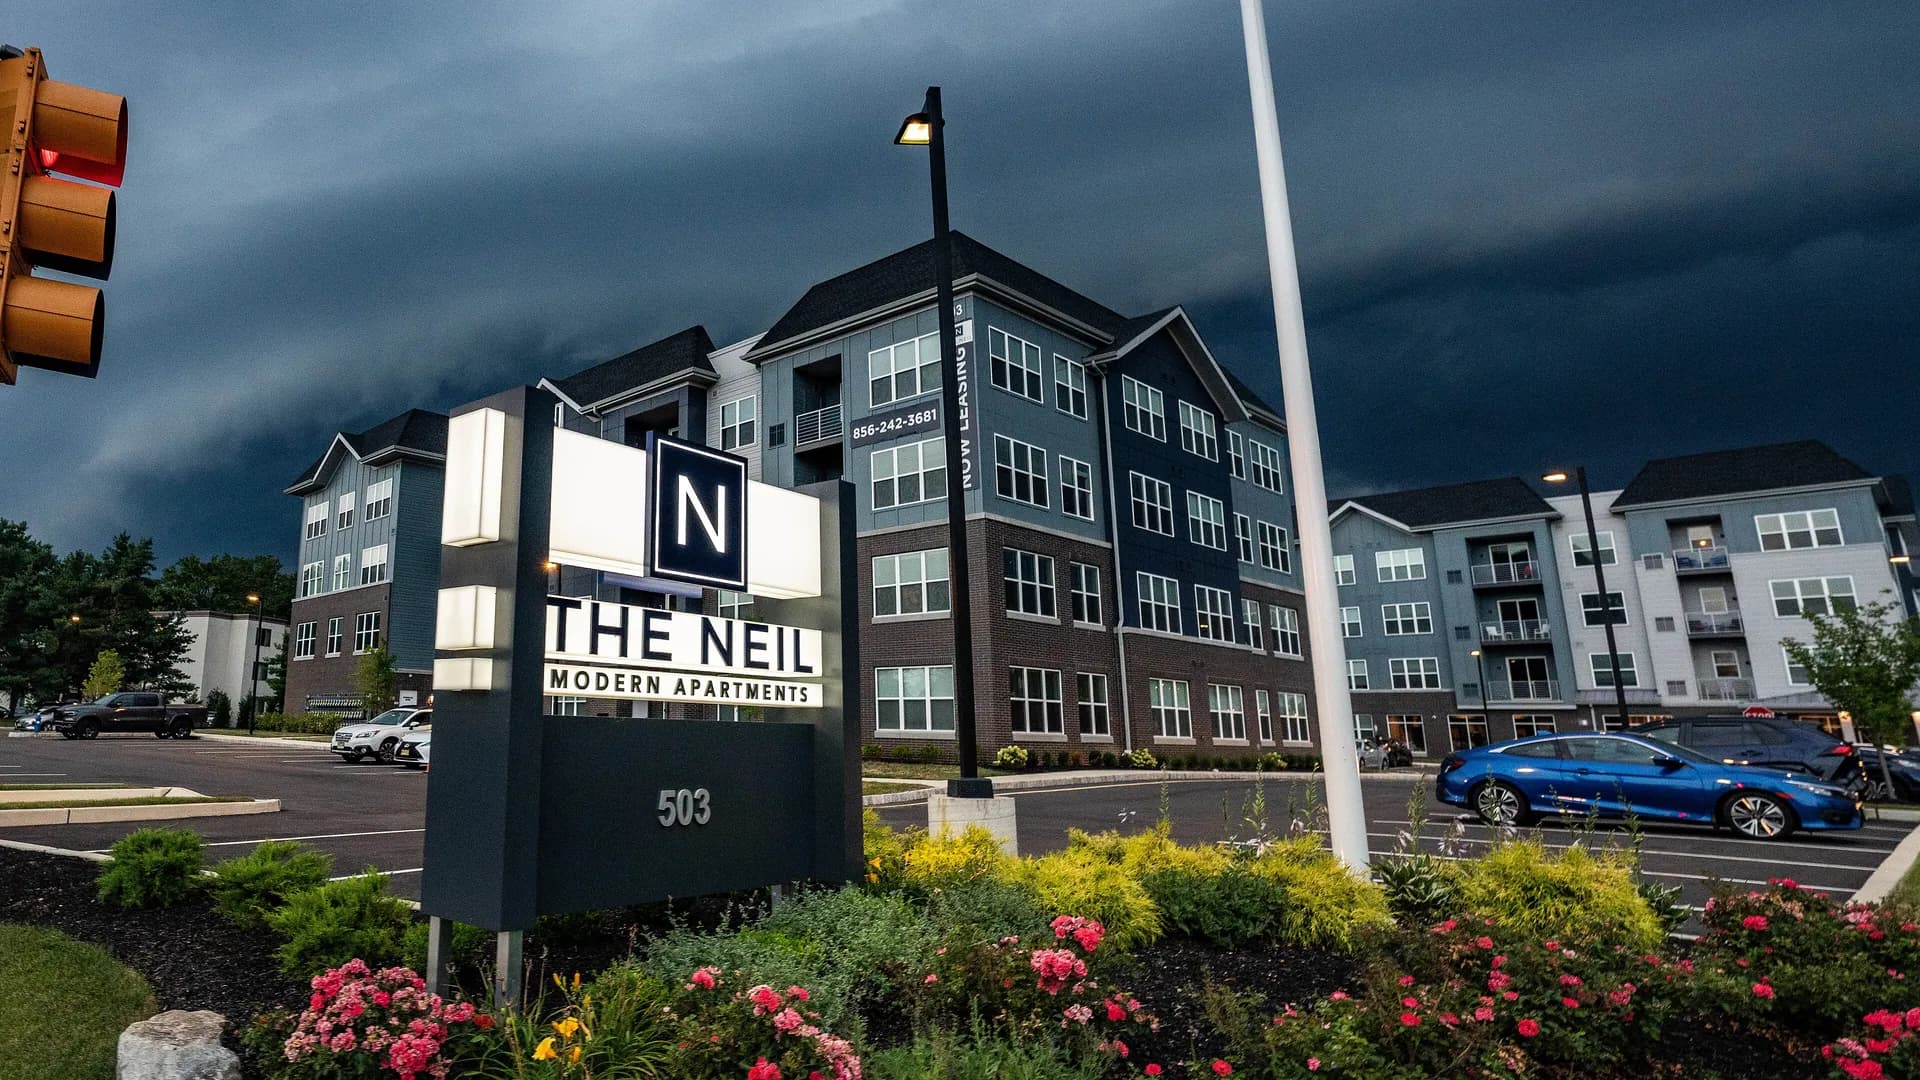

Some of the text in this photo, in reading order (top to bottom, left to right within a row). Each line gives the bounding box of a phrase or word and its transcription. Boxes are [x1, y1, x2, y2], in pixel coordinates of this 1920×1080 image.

[956, 347, 969, 431] LEASING
[853, 408, 937, 439] 856-242-3681
[961, 439, 972, 489] NOW
[677, 475, 727, 553] N
[547, 600, 813, 674] THE NEIL
[550, 669, 808, 702] MODERN APARTMENTS
[657, 788, 711, 828] 503
